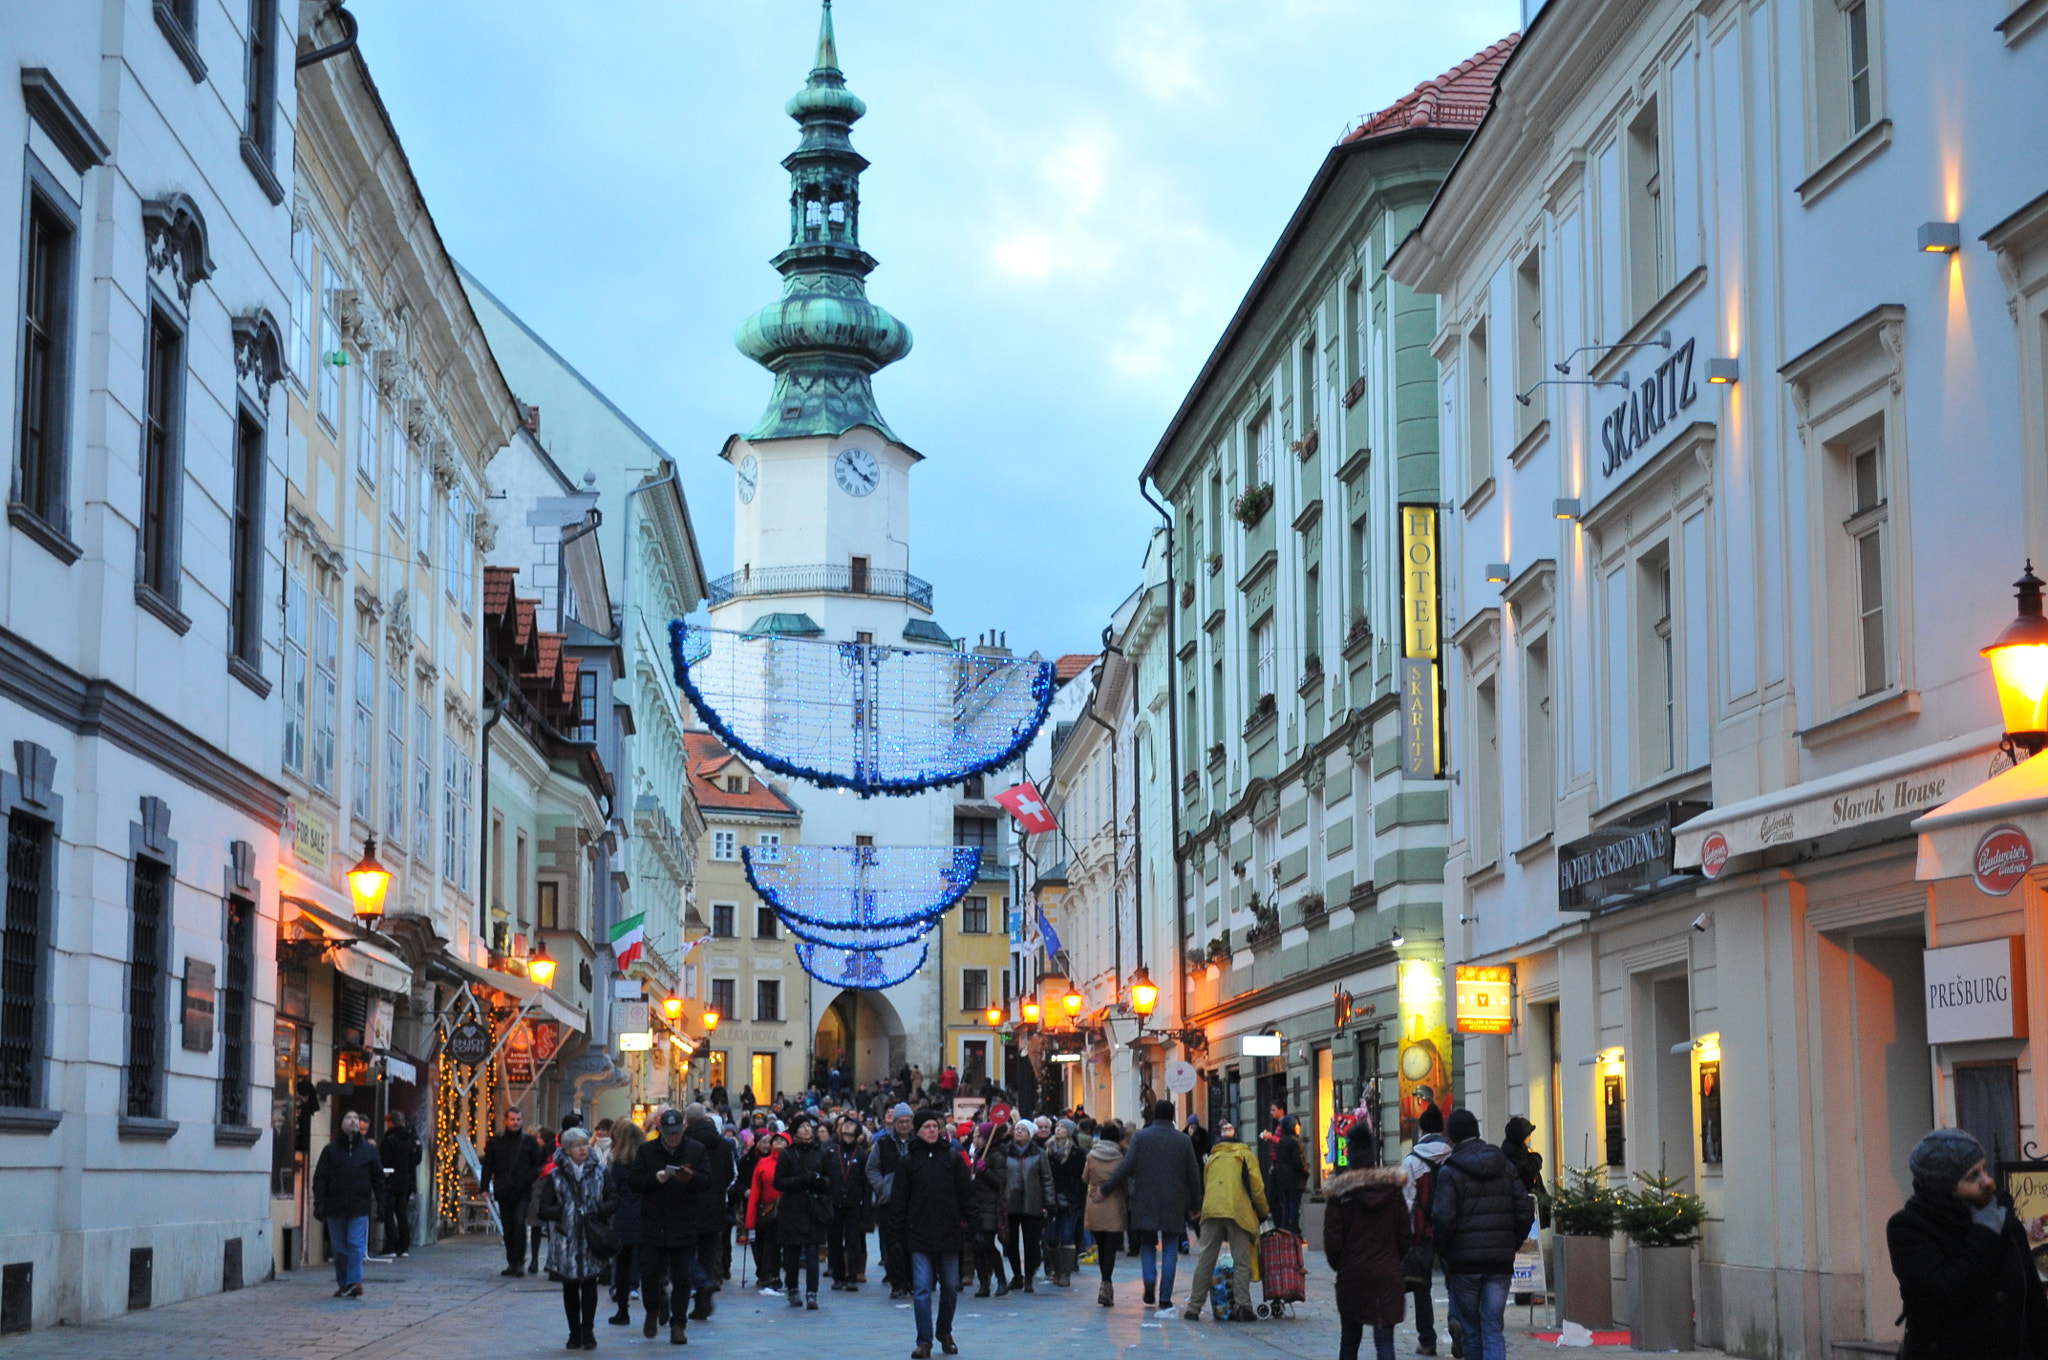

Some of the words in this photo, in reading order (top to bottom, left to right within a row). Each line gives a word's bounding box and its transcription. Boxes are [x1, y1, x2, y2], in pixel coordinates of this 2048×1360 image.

[1601, 337, 1697, 478] SKARITZ
[1408, 513, 1432, 651] HOTEL
[1411, 667, 1425, 772] SKARITZ
[1832, 788, 1884, 825] Slovak
[1893, 778, 1945, 809] House
[296, 820, 309, 845] FOR
[310, 828, 325, 855] SALE
[1560, 853, 1594, 891] HOTEL
[1595, 849, 1605, 880] &
[1605, 824, 1665, 876] RESIDENCE
[1978, 845, 2029, 876] Budweiser
[1998, 860, 2026, 875] Budvar
[1458, 994, 1509, 1006] STYLO
[1930, 974, 2007, 1009] PREŠBURG
